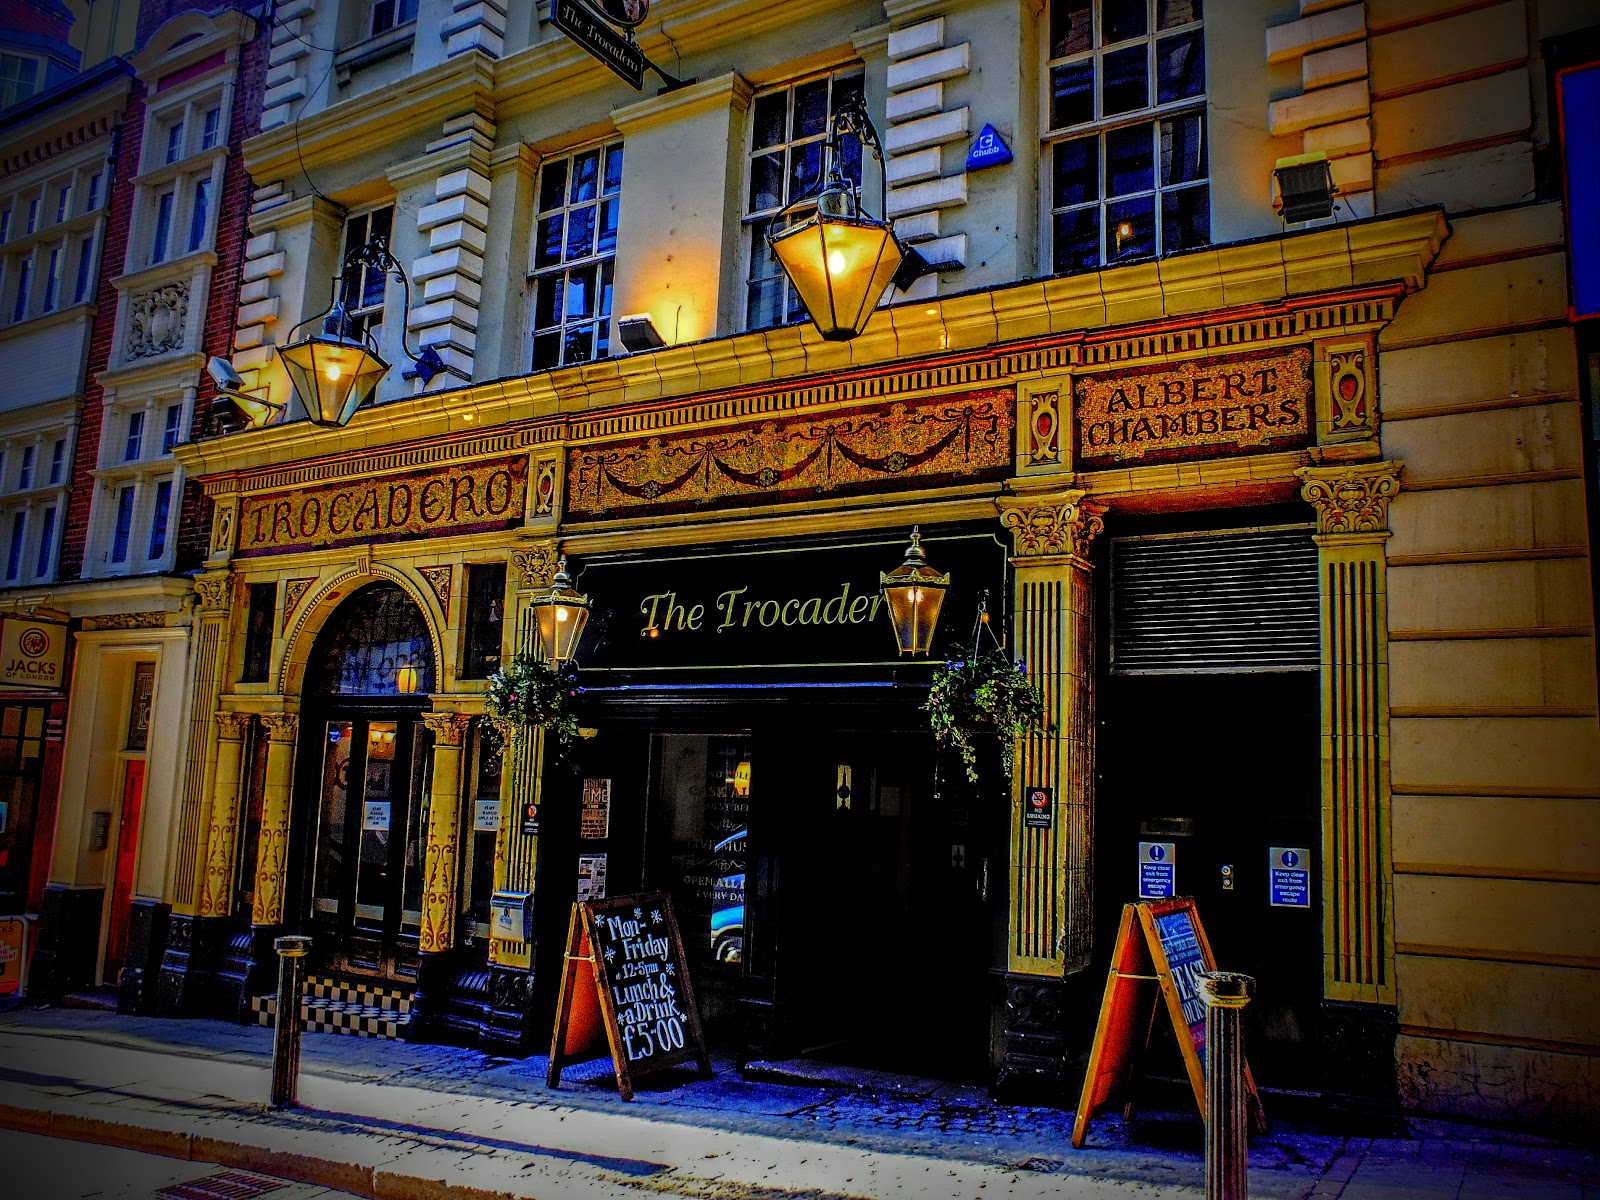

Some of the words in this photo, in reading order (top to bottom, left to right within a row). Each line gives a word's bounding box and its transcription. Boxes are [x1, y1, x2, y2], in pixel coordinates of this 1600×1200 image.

[562, 4, 584, 29] The
[972, 145, 1000, 158] Chubb
[1105, 367, 1279, 415] ALBERT
[1087, 398, 1300, 447] CHAMBERS
[250, 470, 515, 546] TROCADERO
[640, 589, 705, 637] The
[716, 582, 892, 634] Trocader
[6, 659, 56, 675] JACKS
[20, 673, 56, 681] LONDON
[1274, 884, 1306, 892] emergency
[606, 914, 648, 941] Mon-
[621, 932, 669, 962] Friday
[621, 960, 660, 979] 12-5pm
[635, 995, 681, 1021] Drink
